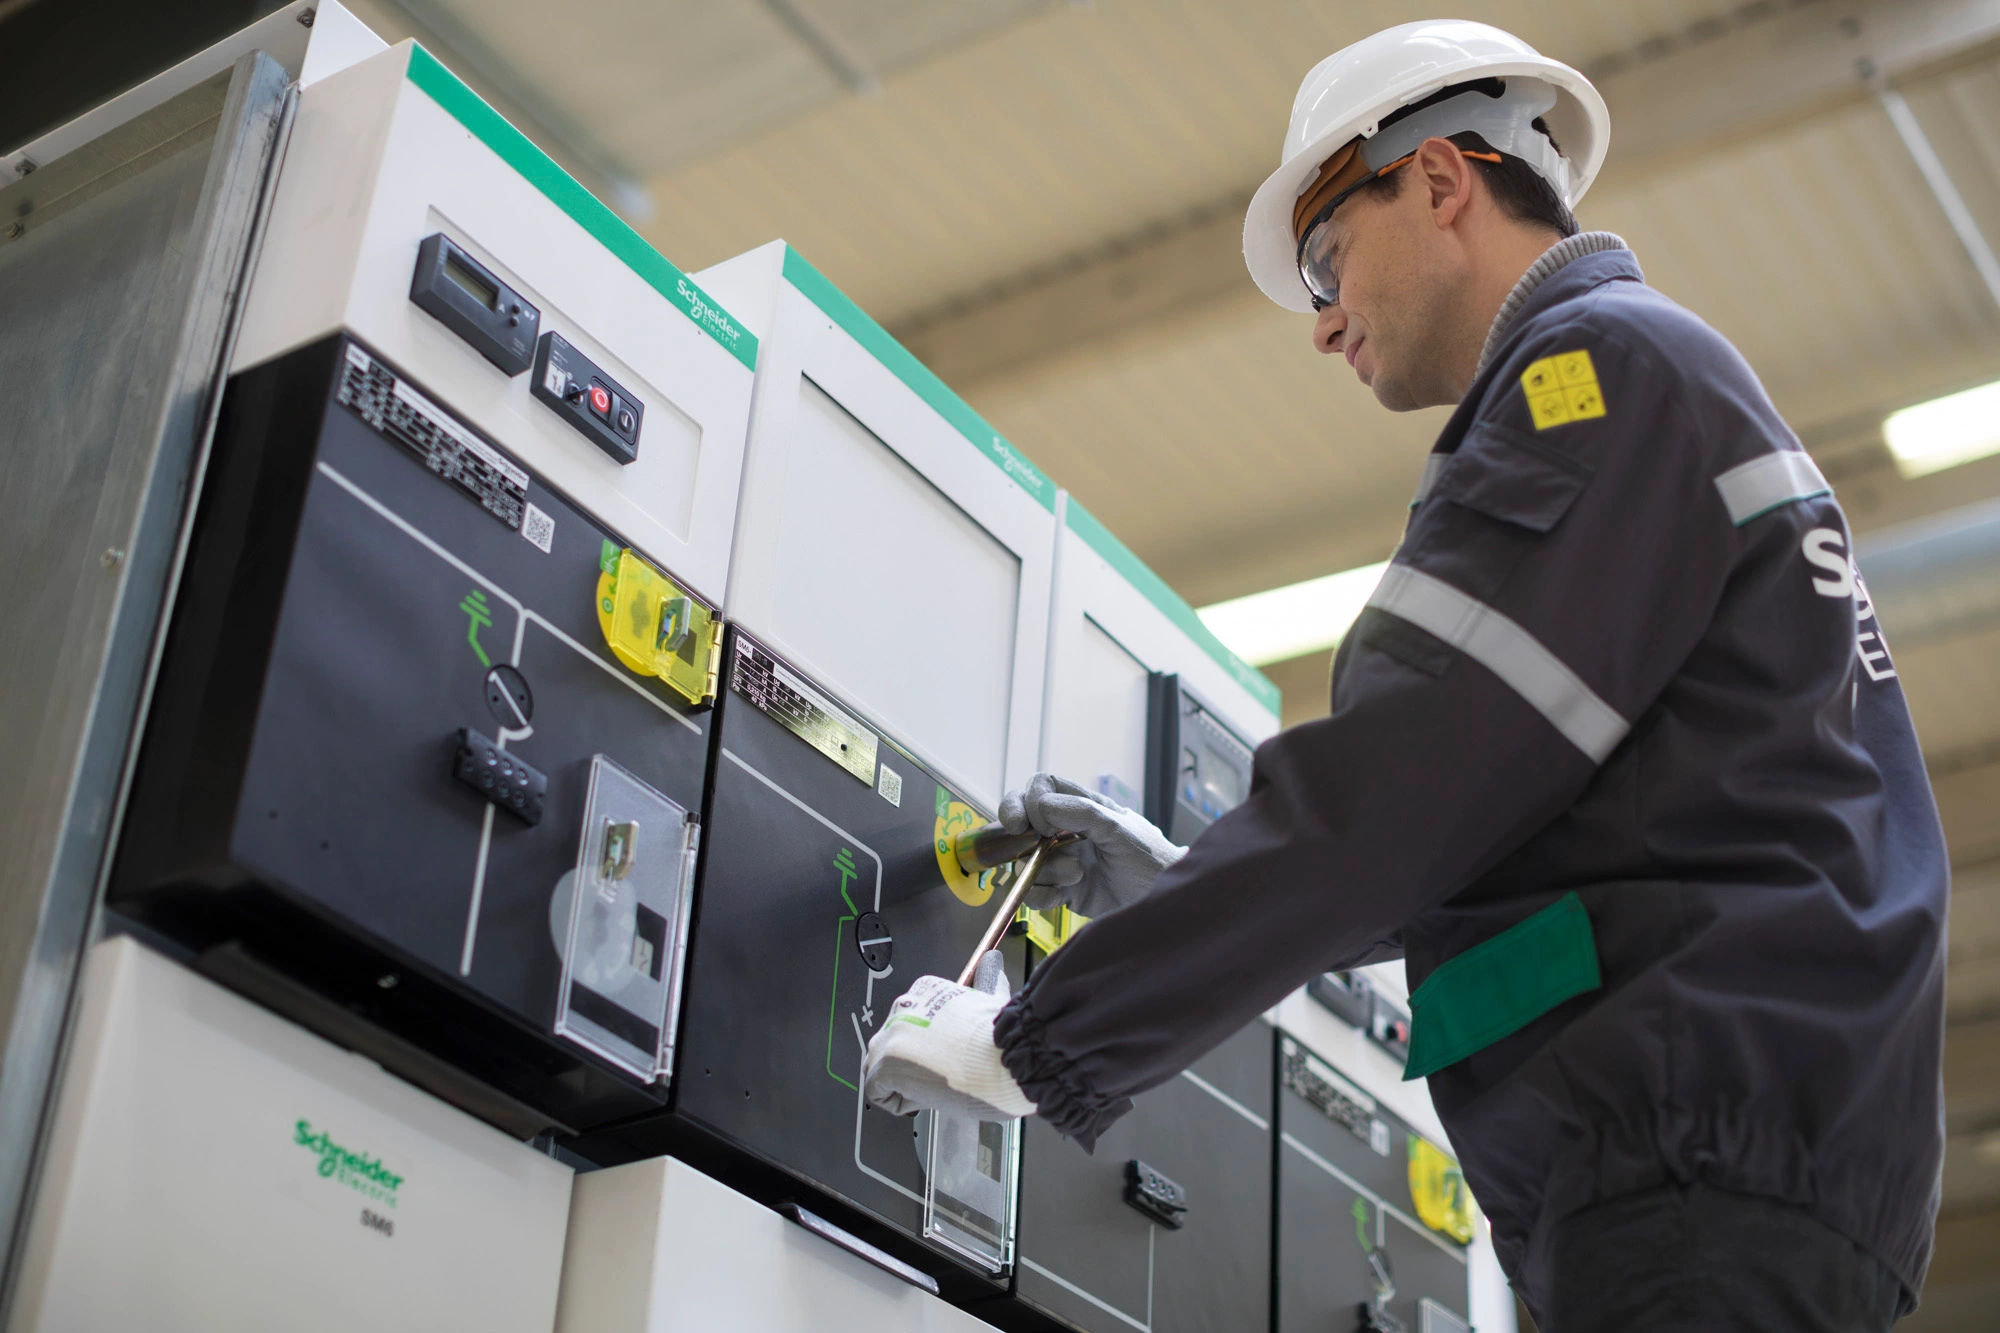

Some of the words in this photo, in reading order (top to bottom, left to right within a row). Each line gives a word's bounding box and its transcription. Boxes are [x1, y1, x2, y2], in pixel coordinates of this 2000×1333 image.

[677, 279, 740, 341] Schneider
[703, 314, 737, 350] Electric
[294, 1120, 404, 1190] Schneider
[359, 1207, 395, 1238] SM6
